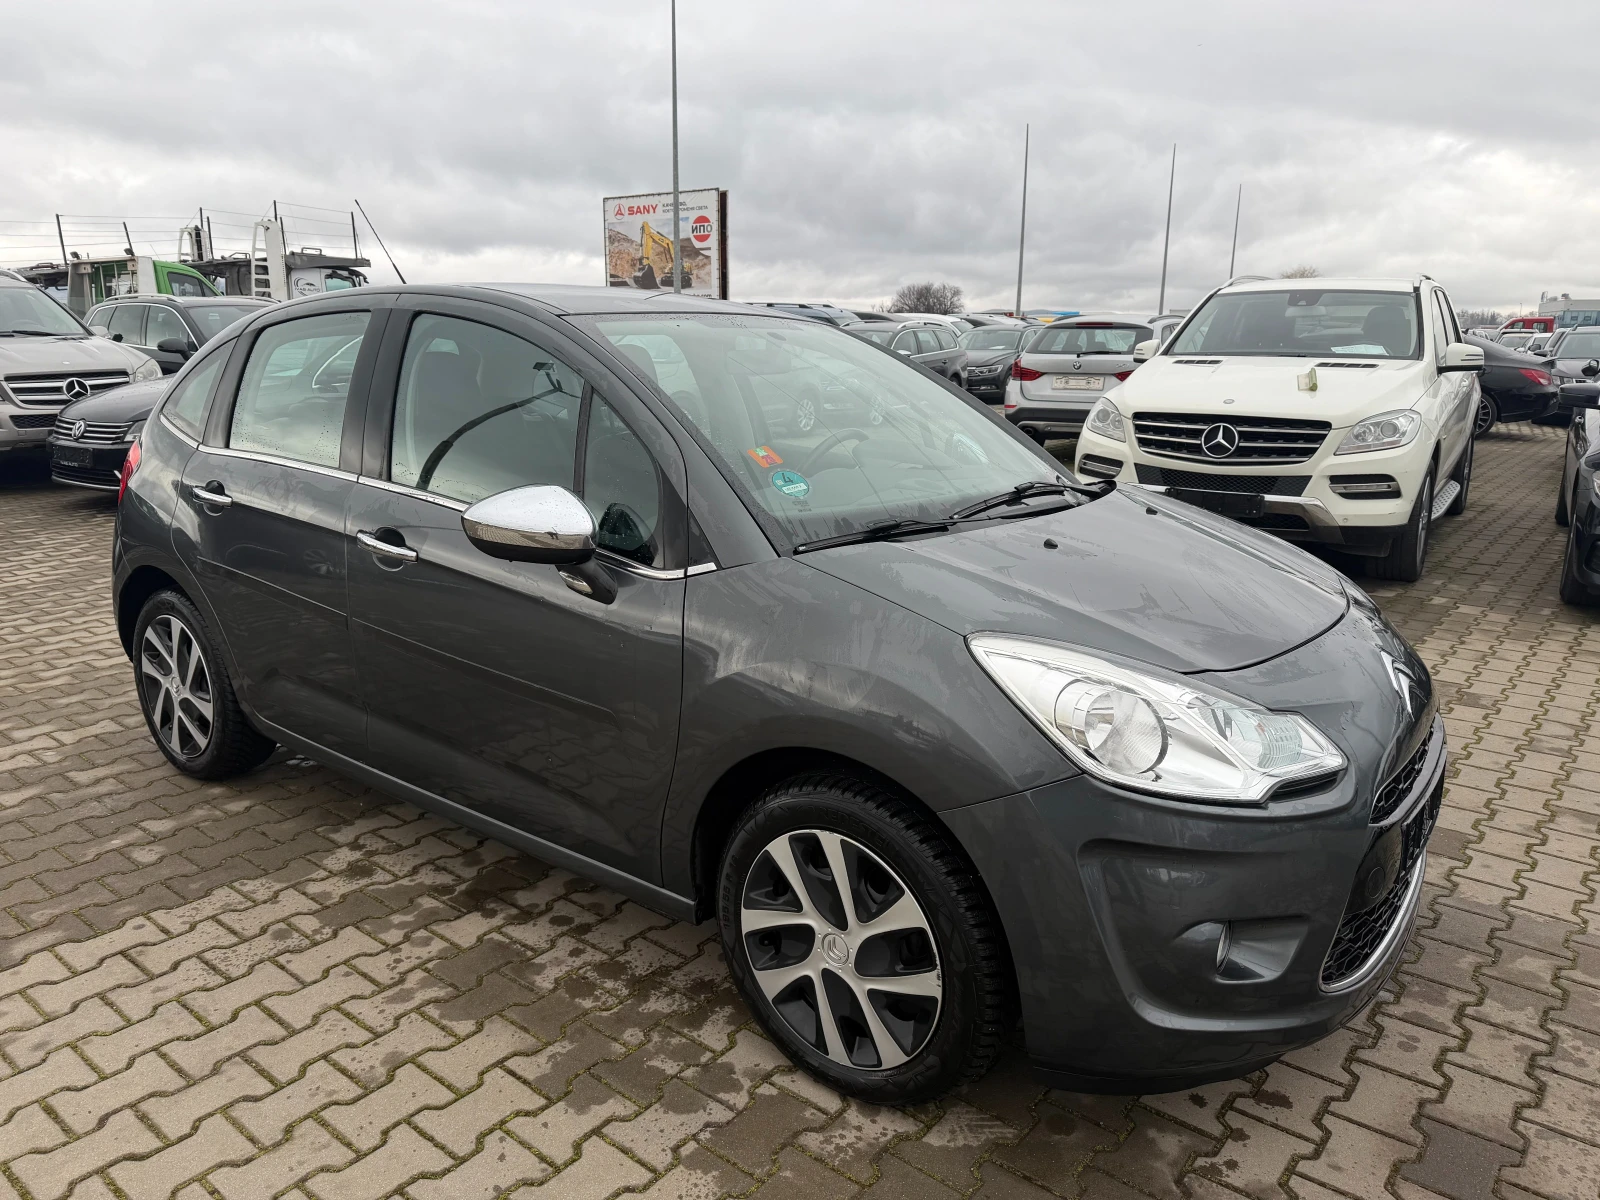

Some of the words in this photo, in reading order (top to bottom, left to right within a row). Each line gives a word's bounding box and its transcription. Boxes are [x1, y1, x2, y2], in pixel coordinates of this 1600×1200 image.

[627, 203, 658, 216] SANY
[691, 224, 713, 235] ИПО
[782, 473, 794, 483] 4
